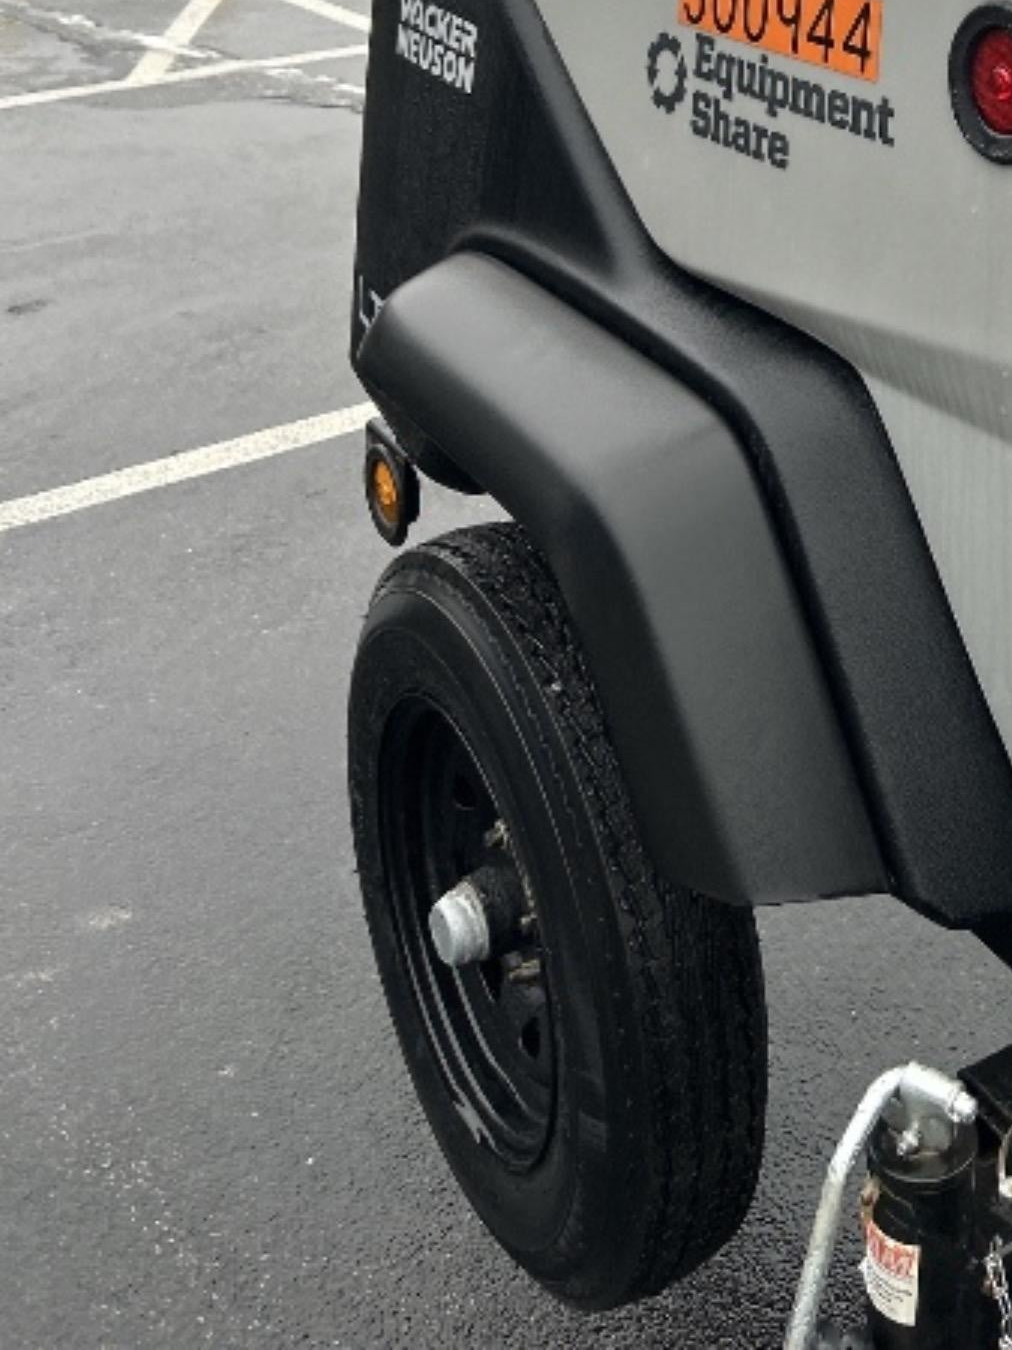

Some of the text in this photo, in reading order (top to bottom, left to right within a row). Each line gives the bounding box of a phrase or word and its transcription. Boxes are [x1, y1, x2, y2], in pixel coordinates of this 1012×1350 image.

[395, 23, 475, 94] NEUSON
[694, 32, 896, 146] Equipment
[690, 92, 790, 170] Share
